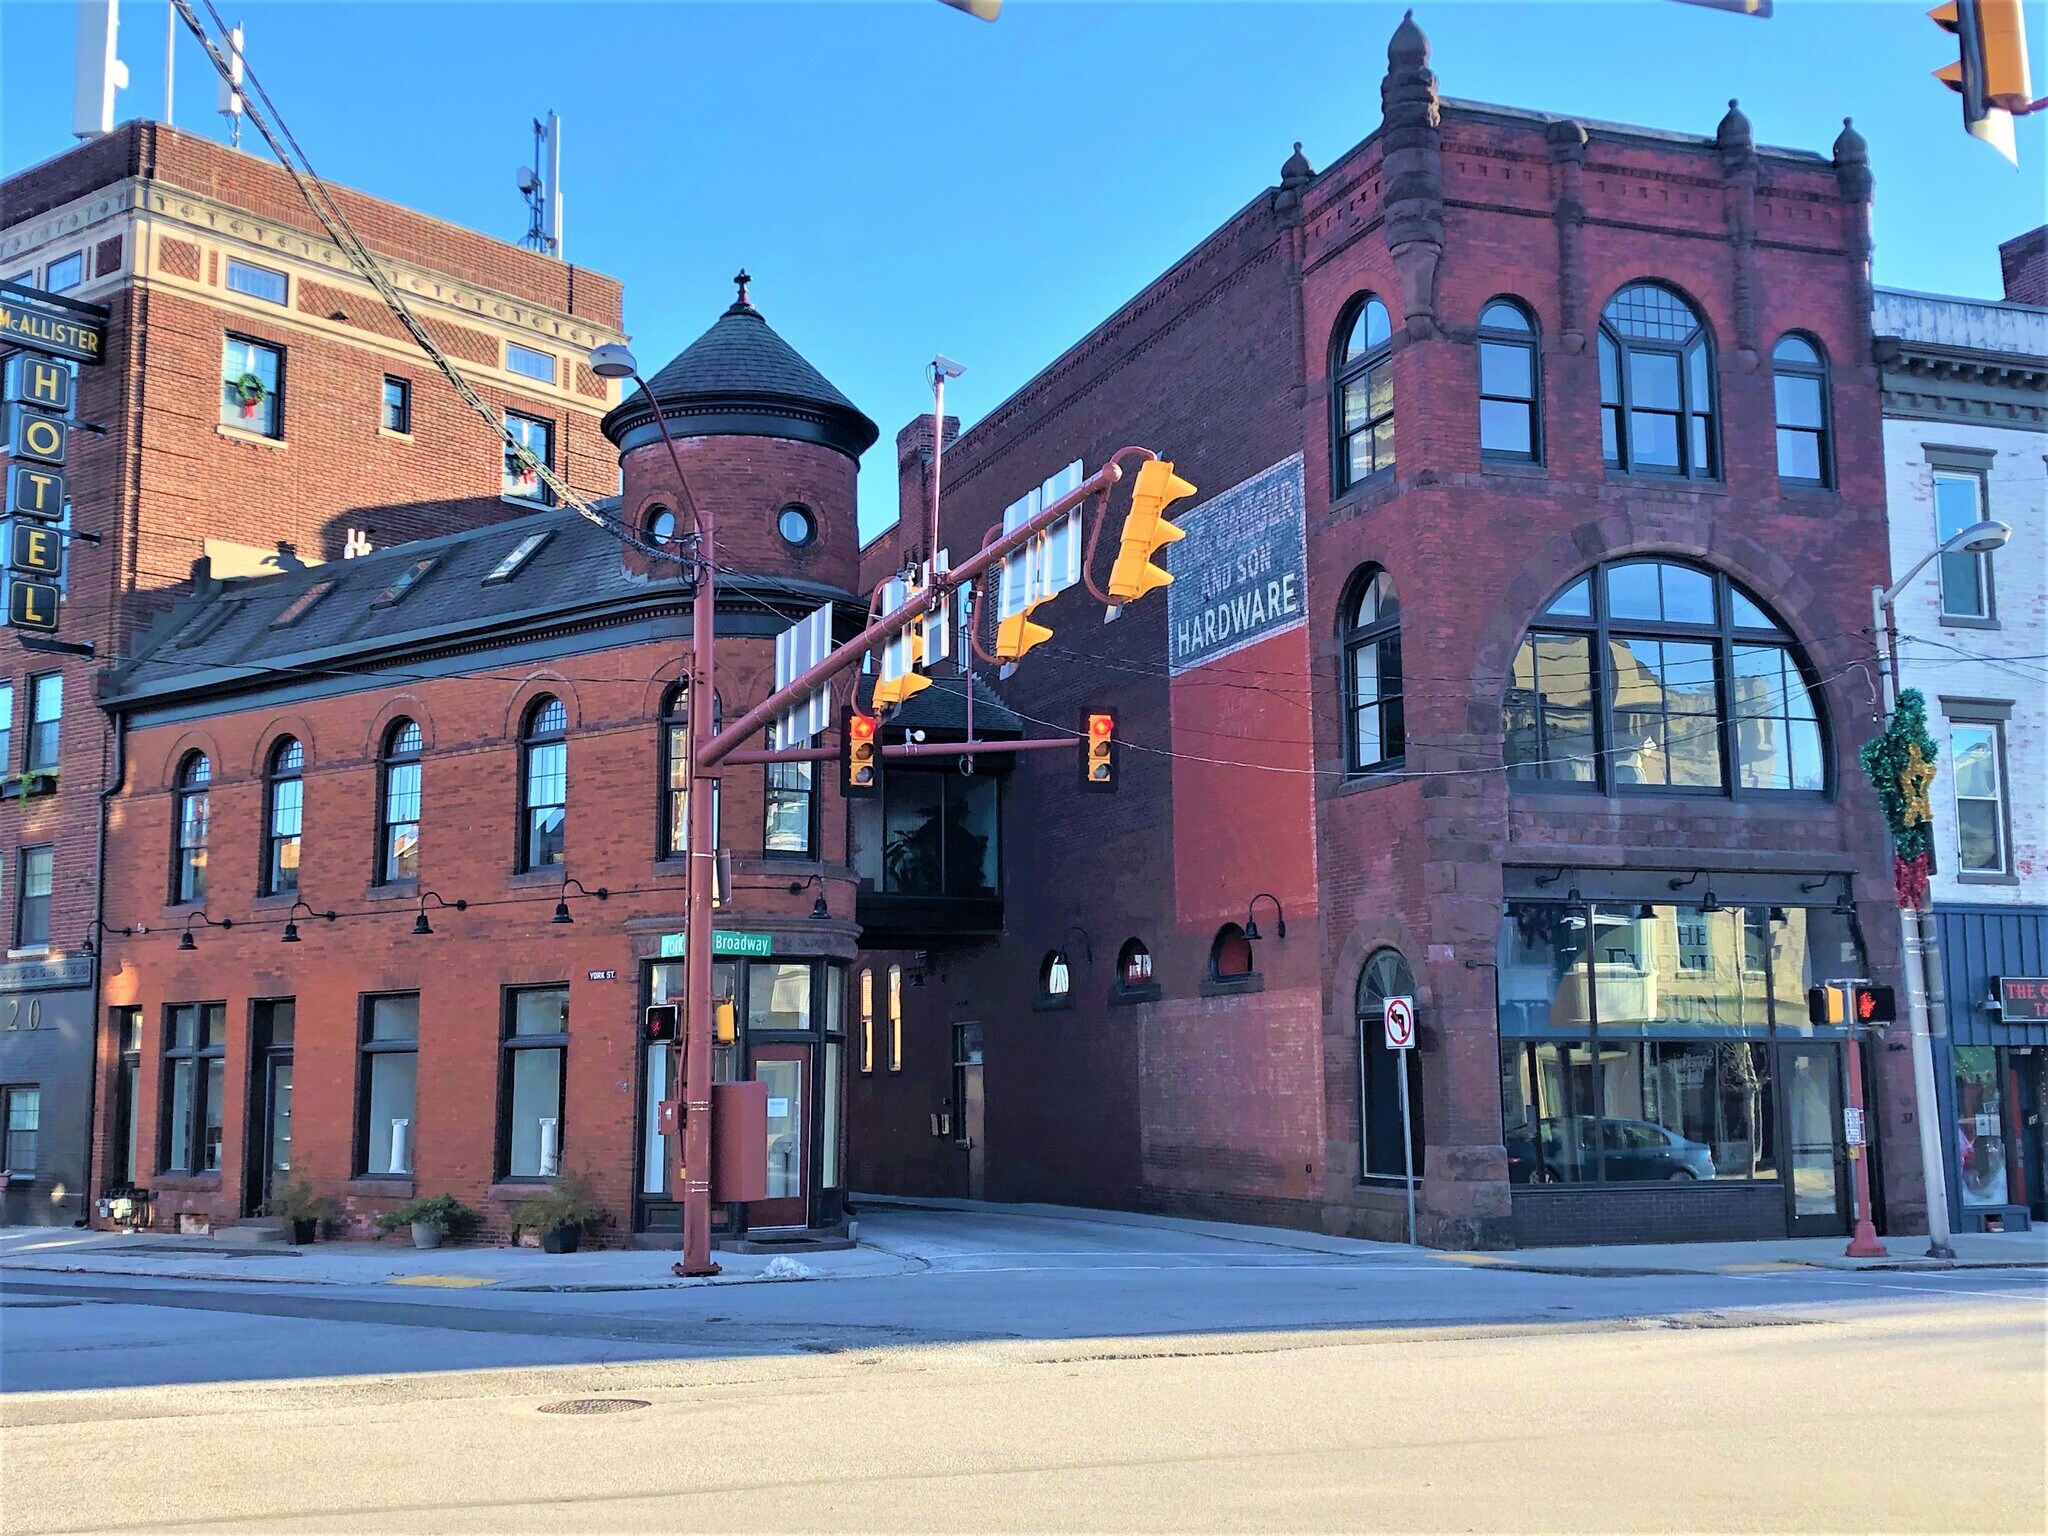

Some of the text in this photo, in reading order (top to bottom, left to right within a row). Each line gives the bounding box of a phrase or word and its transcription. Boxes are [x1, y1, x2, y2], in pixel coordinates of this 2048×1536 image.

[0, 308, 98, 352] McALLISTER
[25, 365, 59, 622] HOTEL
[1201, 541, 1271, 601] AND SON
[1177, 572, 1297, 657] HARDWARE
[715, 935, 769, 956] Broadway
[1656, 919, 1708, 946] THE
[590, 971, 605, 980] YORK
[2006, 983, 2038, 999] THE
[8, 999, 40, 1030] 20
[1654, 988, 1725, 1024] SUN
